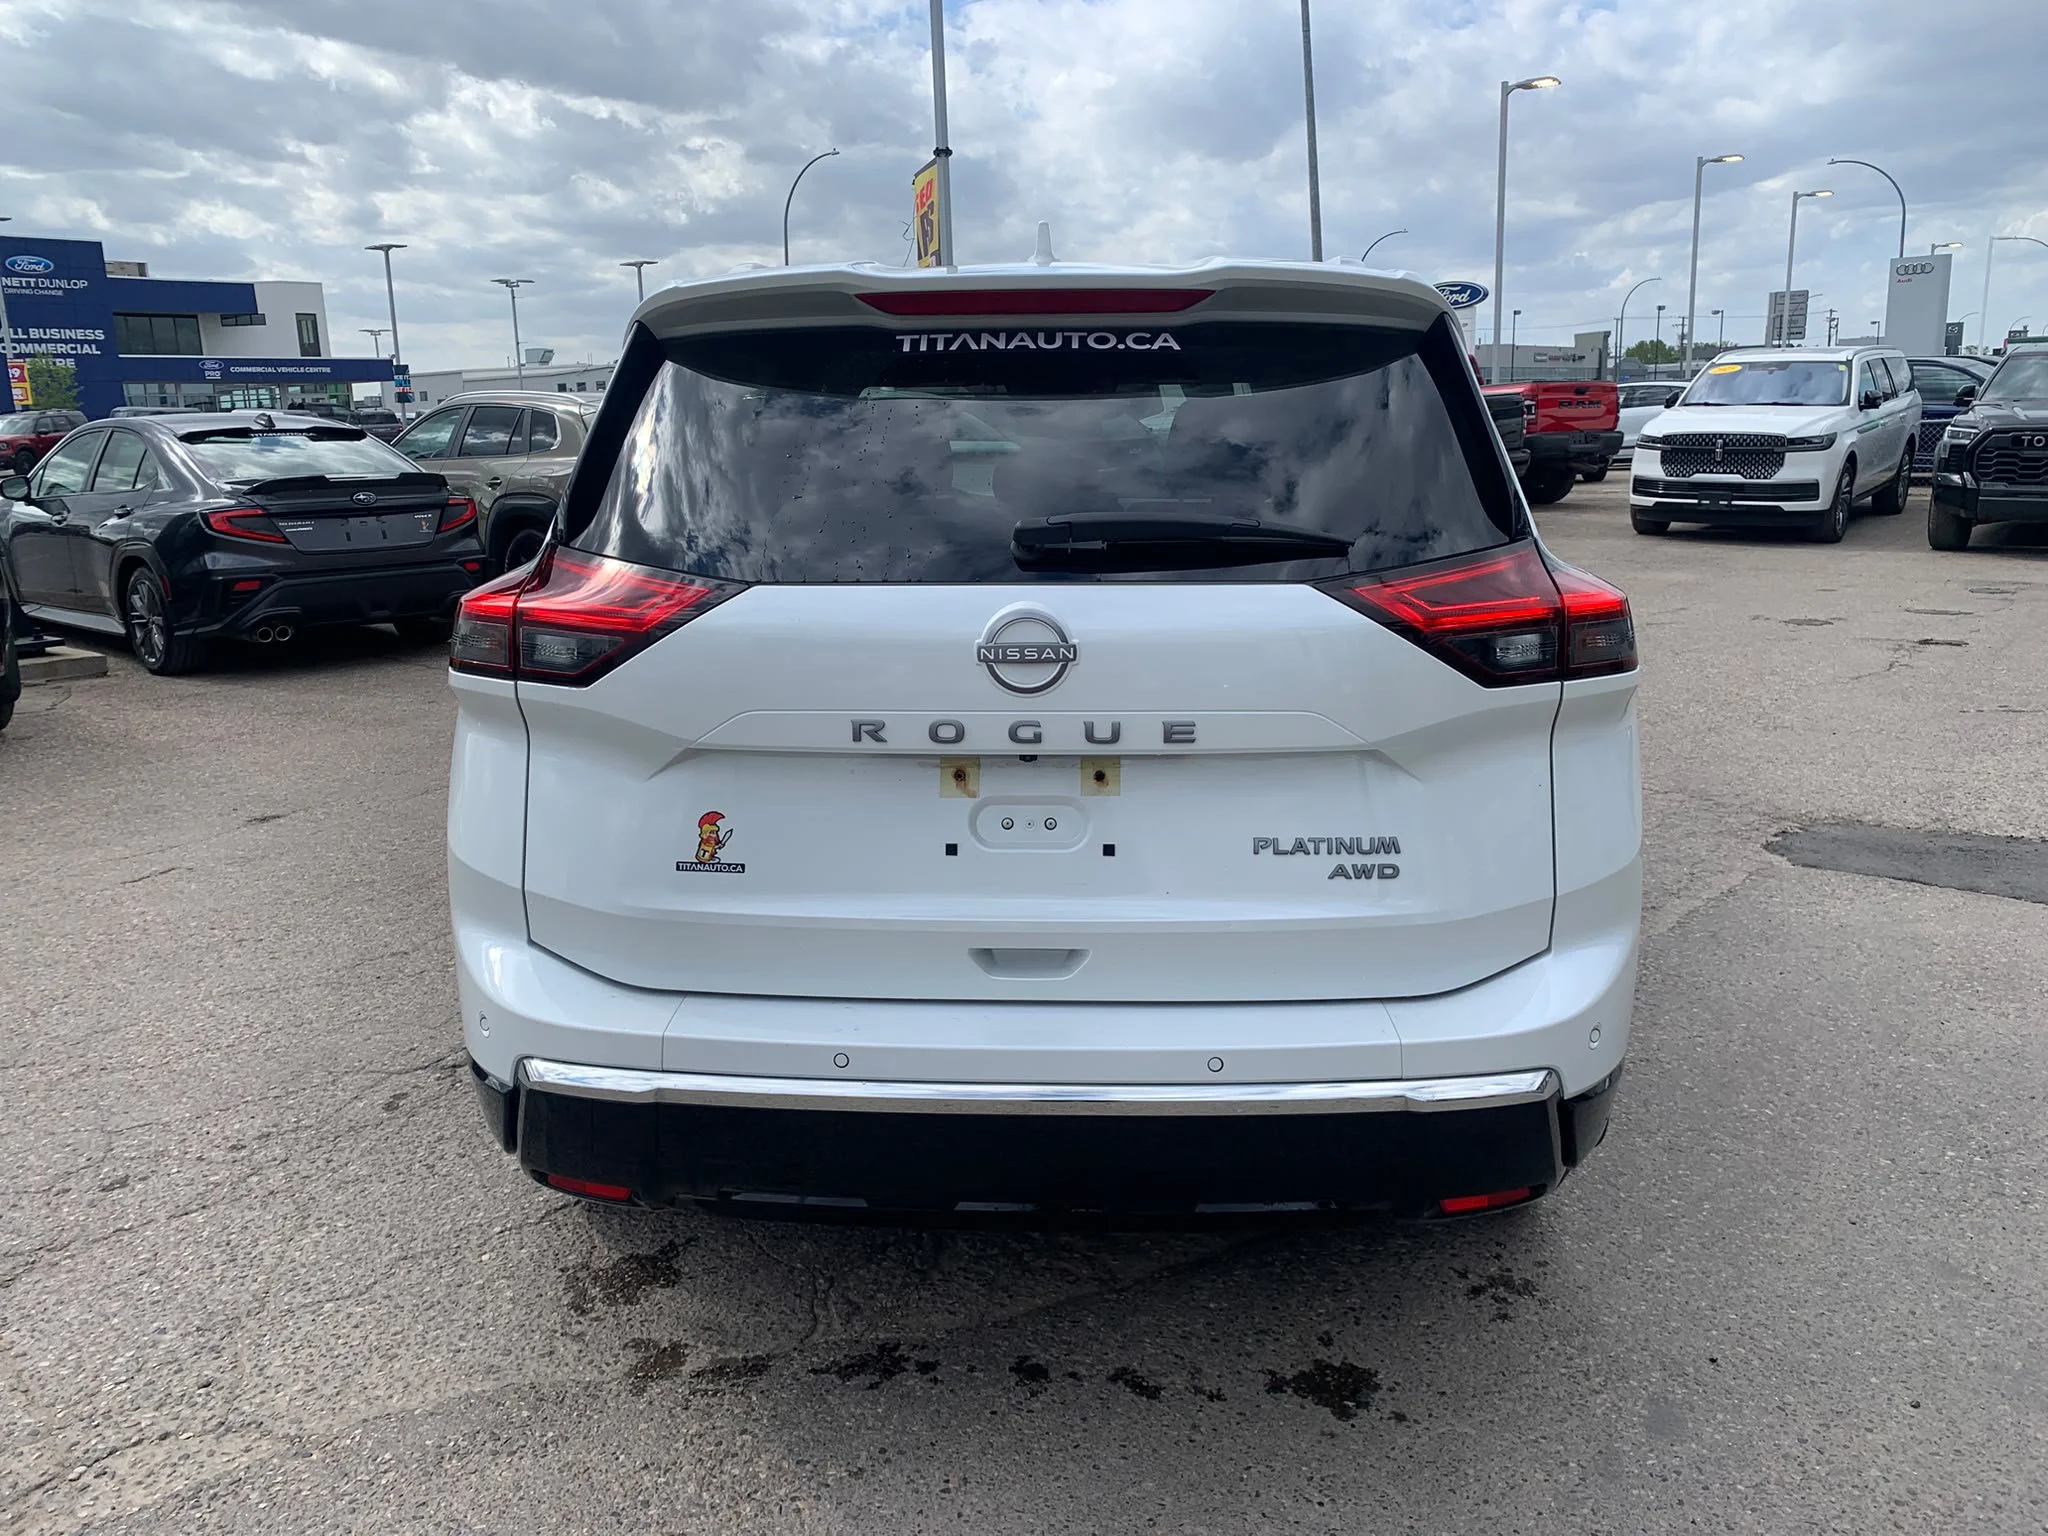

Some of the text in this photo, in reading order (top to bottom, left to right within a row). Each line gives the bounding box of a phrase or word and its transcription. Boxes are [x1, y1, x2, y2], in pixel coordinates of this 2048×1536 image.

[15, 258, 45, 271] Ford
[38, 279, 88, 289] DUNLOP
[4, 287, 63, 296] DRIVING CHANGE
[28, 328, 105, 340] BUSINESS
[896, 332, 1181, 352] TITANAUTO.CA
[980, 647, 1074, 660] NISSAN
[850, 719, 1196, 745] ROGUE
[1252, 836, 1402, 855] PLATINUM
[677, 862, 743, 873] TITANAUTO.CA
[1327, 863, 1401, 880] AWD
